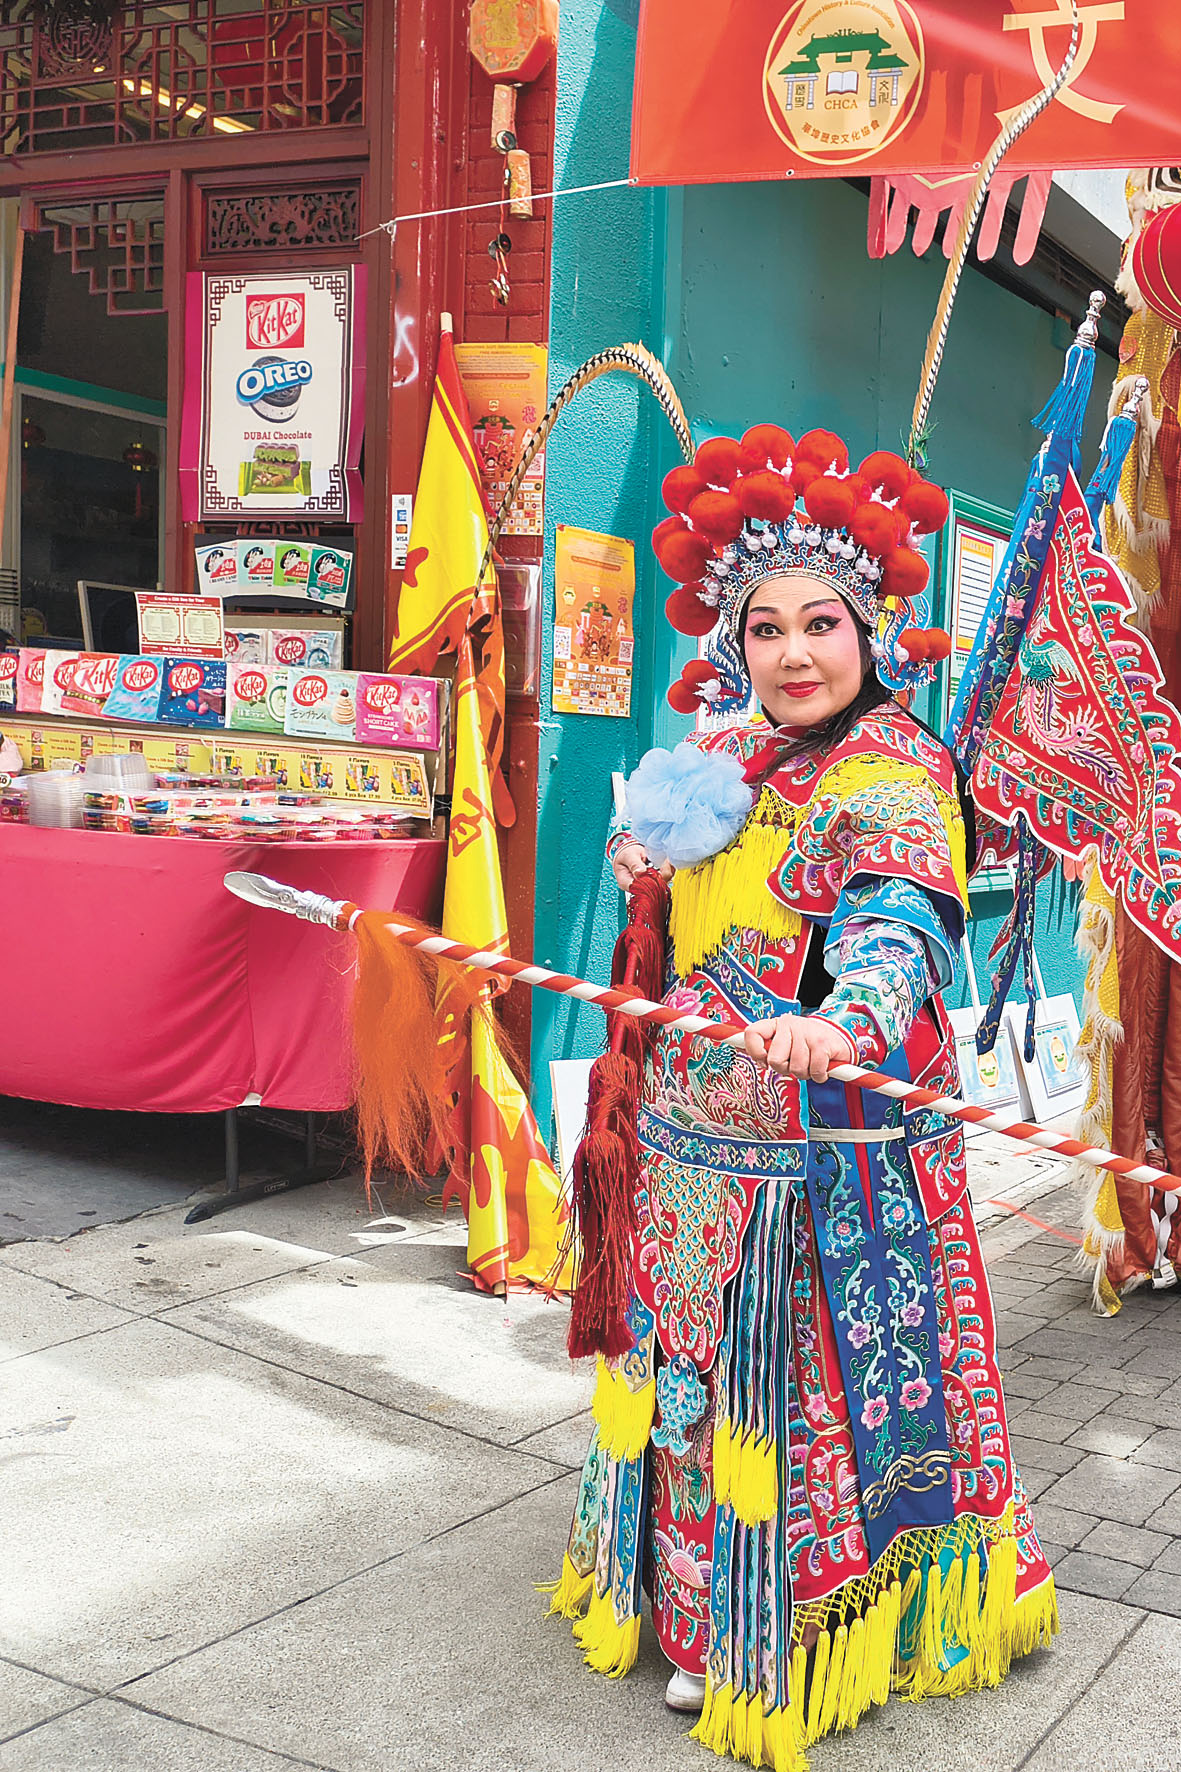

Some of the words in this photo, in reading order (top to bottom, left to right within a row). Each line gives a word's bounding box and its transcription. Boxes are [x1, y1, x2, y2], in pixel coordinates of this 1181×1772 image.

[824, 99, 858, 111] CHCA
[257, 301, 298, 343] KitKat
[239, 361, 311, 397] OREO
[243, 431, 272, 441] DUBAI
[273, 430, 312, 440] Chocolate
[280, 641, 302, 660] KitKat
[129, 665, 155, 689] KitKat
[174, 667, 199, 688] KitKat
[240, 676, 262, 696] KitKat
[299, 680, 323, 701] KitKat
[369, 685, 396, 706] KitKat
